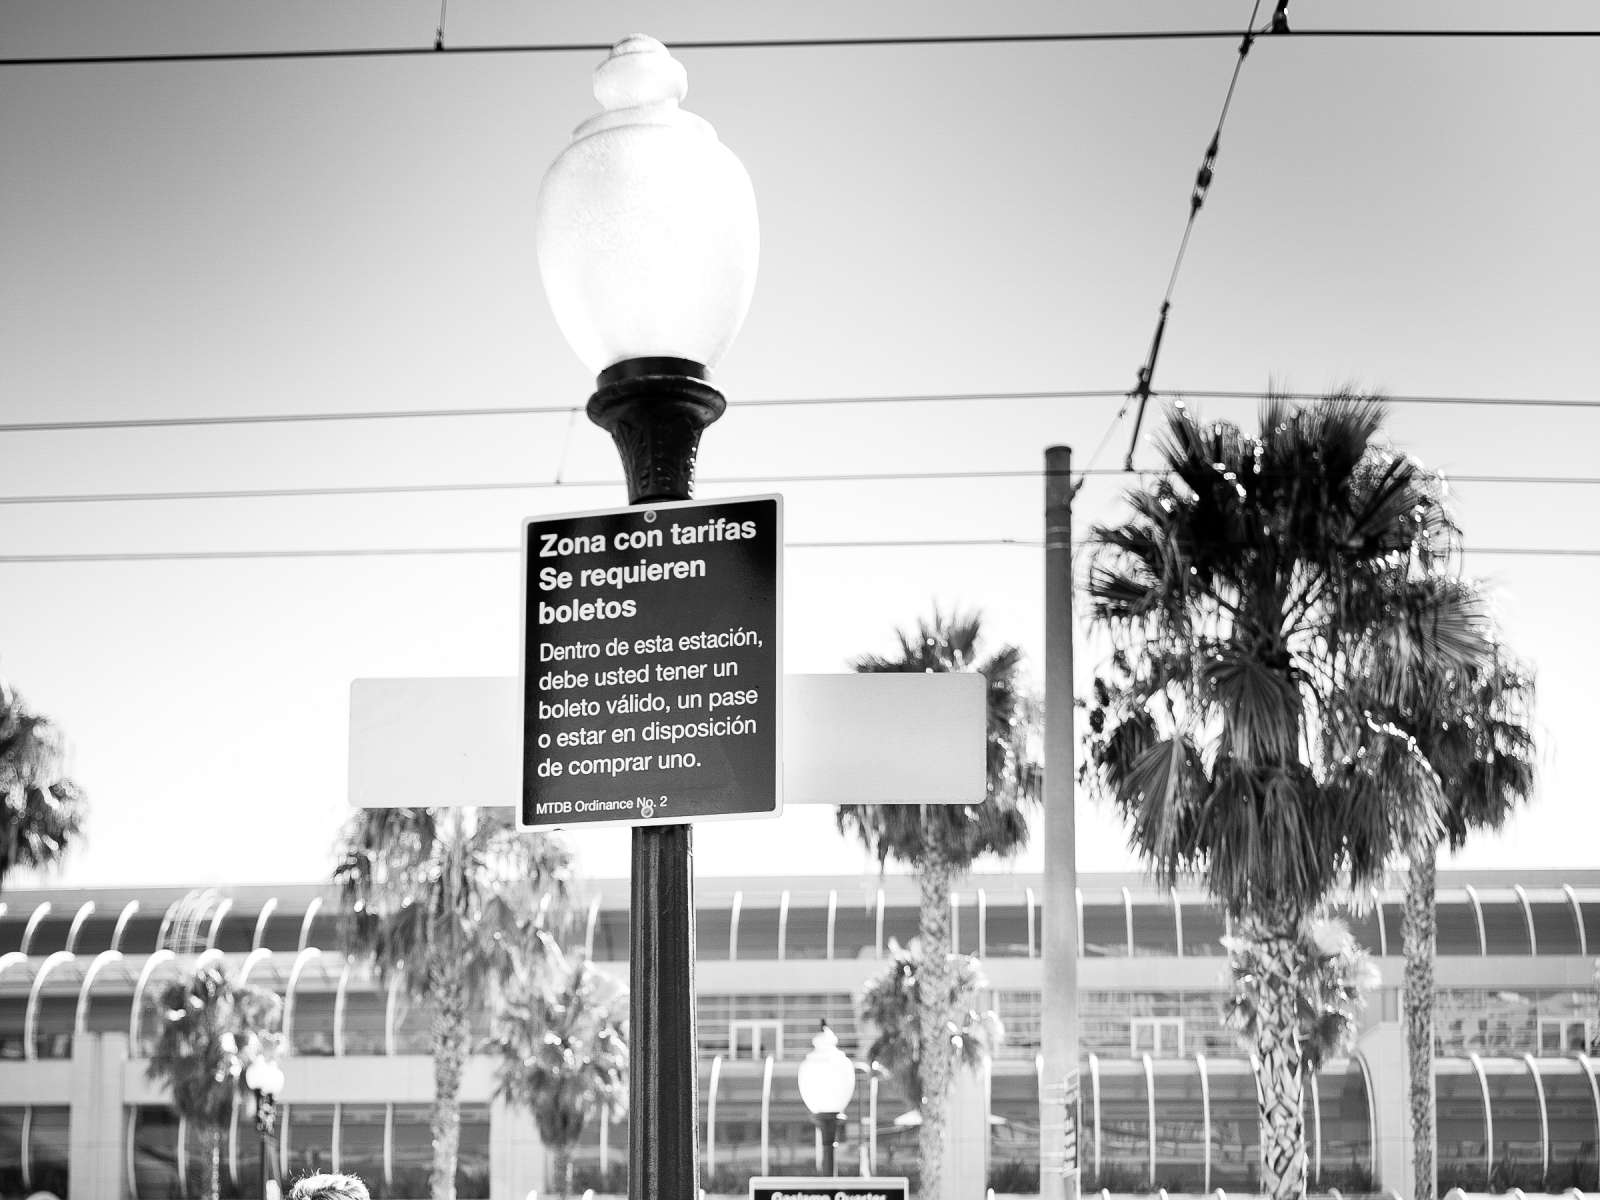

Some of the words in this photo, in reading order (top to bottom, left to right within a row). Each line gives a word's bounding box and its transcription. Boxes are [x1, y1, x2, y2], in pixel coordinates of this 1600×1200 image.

[539, 531, 606, 558] Zona
[613, 528, 663, 552] con
[670, 517, 757, 546] tarifas
[539, 567, 573, 591] Se
[580, 557, 706, 589] requieren
[539, 598, 637, 625] boletos
[540, 640, 600, 662] Dentro
[605, 637, 629, 657] de
[634, 634, 673, 654] esta
[679, 626, 763, 653] estación,
[539, 670, 589, 691] debe
[594, 664, 649, 687] usted
[655, 661, 707, 682] tener
[713, 659, 738, 677] un
[539, 698, 600, 720] boleto
[606, 693, 671, 715] válido,
[677, 691, 702, 709] un
[708, 687, 758, 714] pase
[538, 731, 551, 748] o
[556, 727, 606, 747] estar
[611, 725, 636, 743] en
[641, 715, 757, 743] disposición
[538, 756, 562, 777] de
[568, 753, 652, 777] comprar
[658, 751, 701, 771] uno.
[537, 802, 572, 815] MTDB
[575, 798, 633, 811] Ordinance
[637, 796, 656, 810] No.
[659, 795, 668, 807] 2
